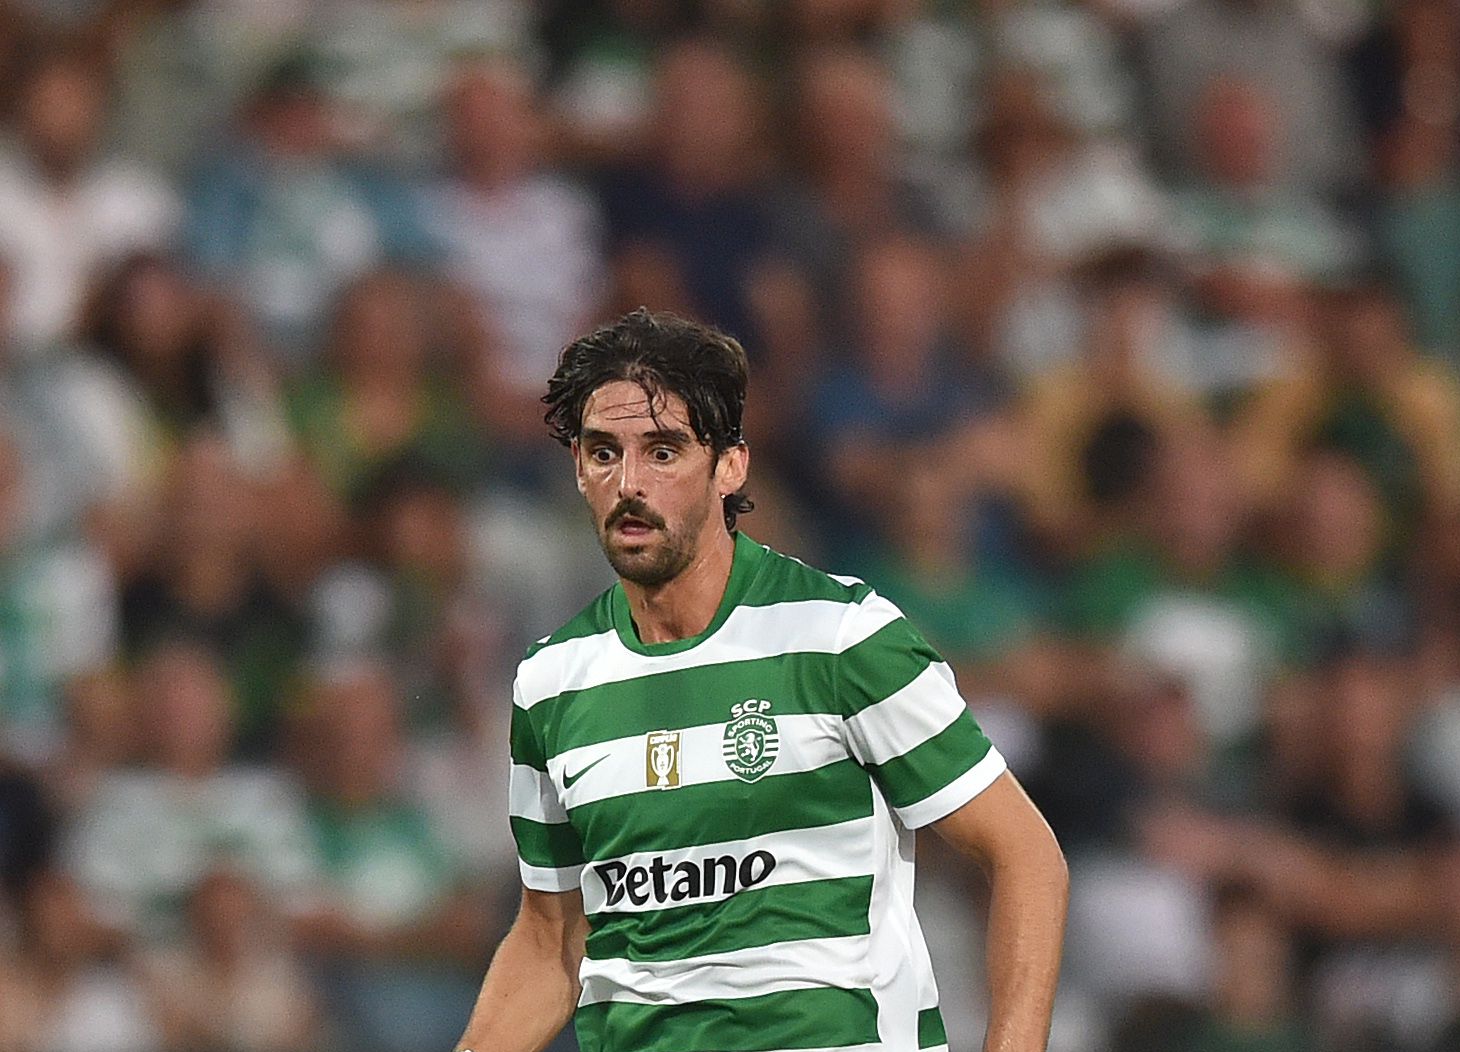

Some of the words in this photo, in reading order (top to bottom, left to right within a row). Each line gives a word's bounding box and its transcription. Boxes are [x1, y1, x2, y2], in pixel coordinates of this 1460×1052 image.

[730, 698, 772, 719] SCP
[727, 717, 773, 738] SPORTING
[729, 760, 773, 775] PORTUGAL
[593, 850, 776, 907] Betano
